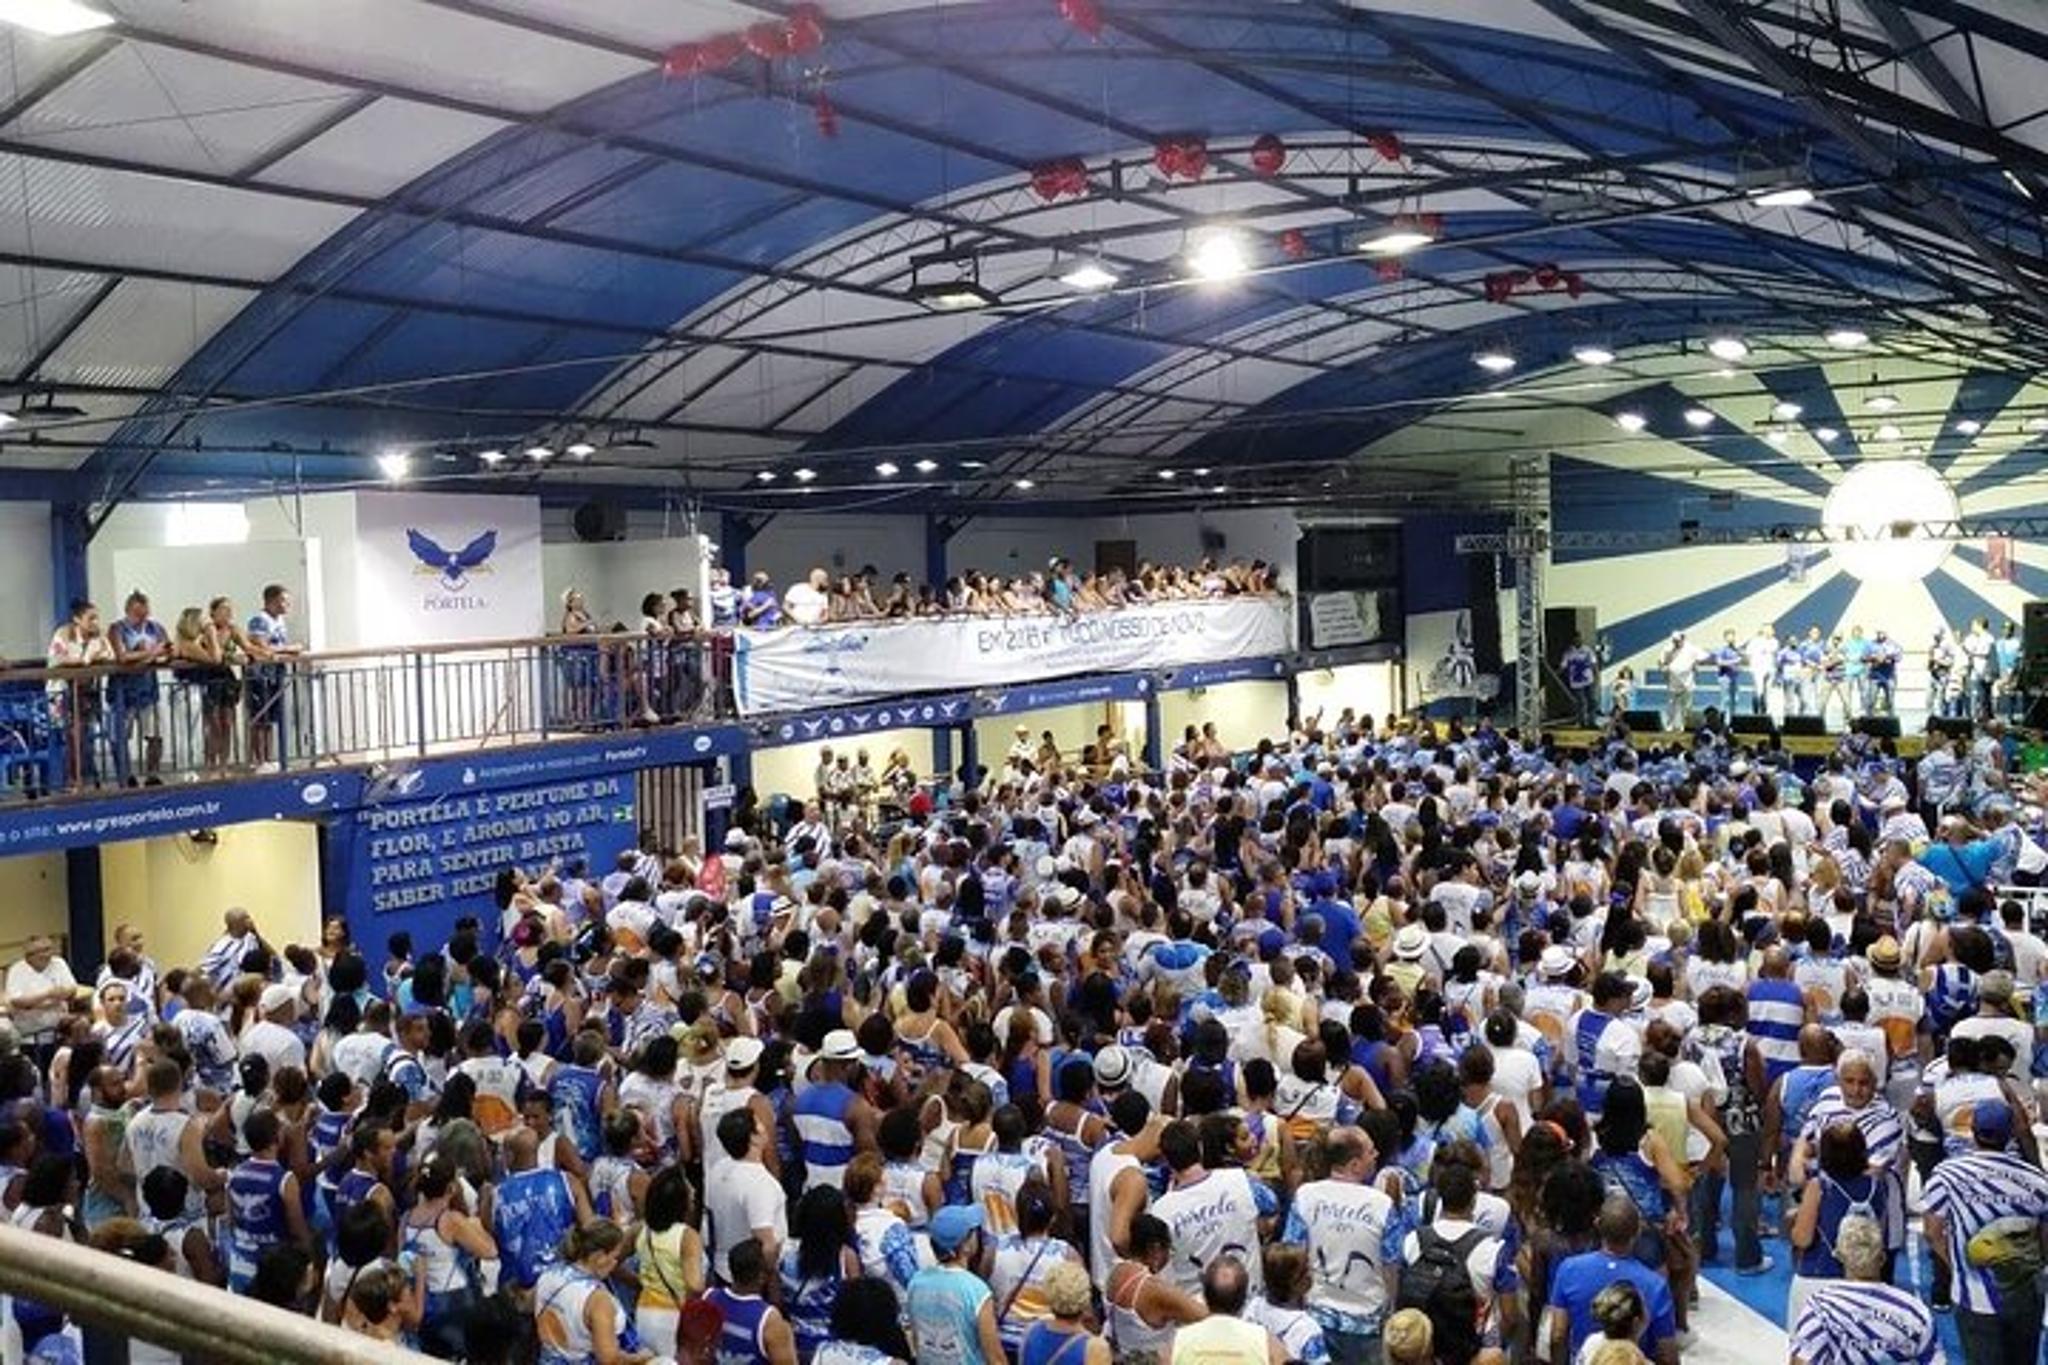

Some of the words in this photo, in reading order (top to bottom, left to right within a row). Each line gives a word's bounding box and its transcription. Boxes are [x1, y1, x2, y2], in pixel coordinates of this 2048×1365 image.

[497, 784, 589, 812] PERFUME
[593, 779, 619, 797] DA
[56, 800, 221, 835] www.gresportela.com.br
[371, 834, 438, 858] FLOR,
[463, 816, 538, 843] AROMA
[544, 809, 570, 829] NO
[372, 856, 433, 885] PARA
[441, 844, 515, 873] SENTIR
[520, 832, 585, 860] BASTA
[373, 881, 445, 911] SABER
